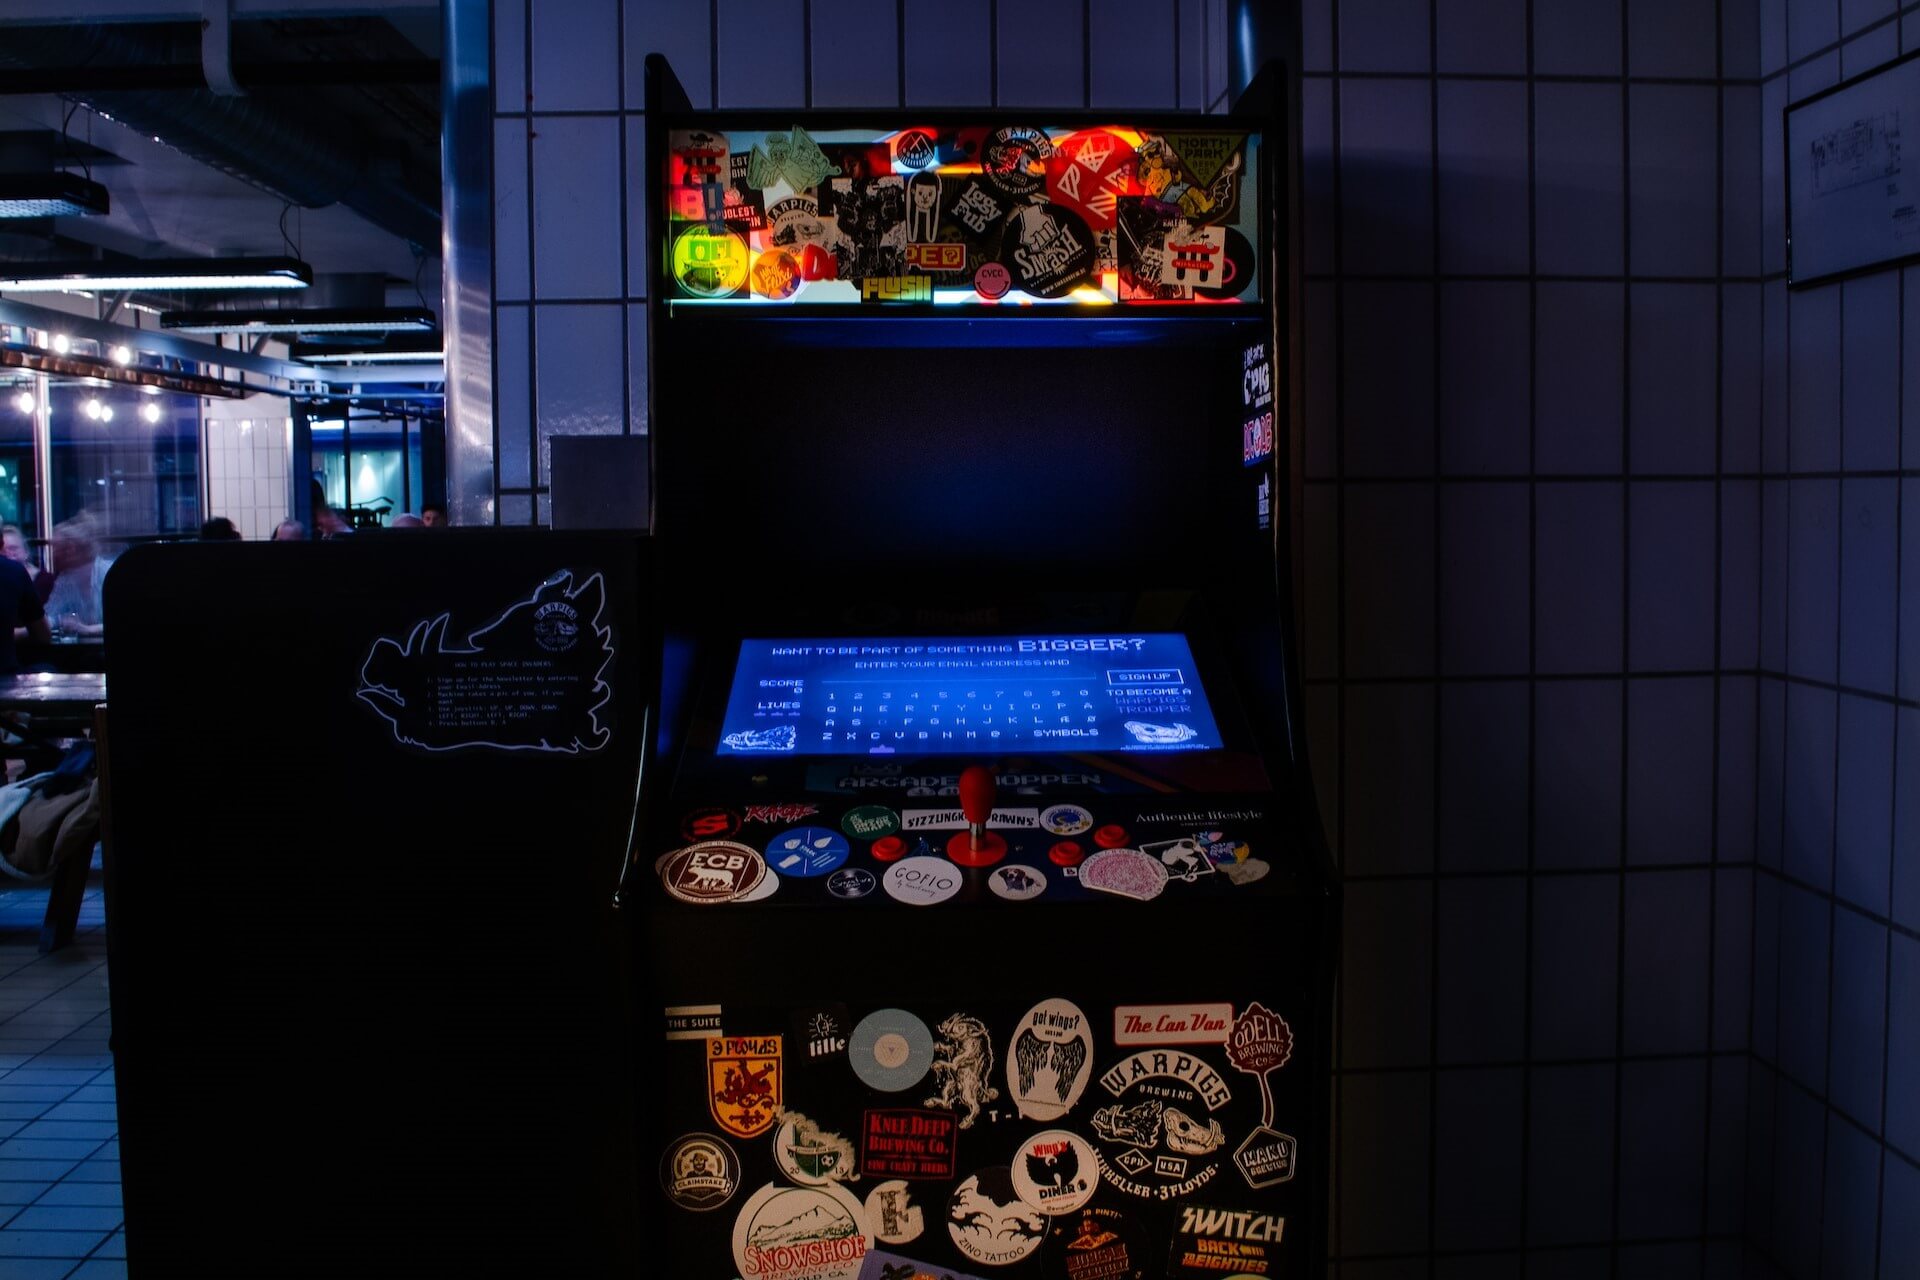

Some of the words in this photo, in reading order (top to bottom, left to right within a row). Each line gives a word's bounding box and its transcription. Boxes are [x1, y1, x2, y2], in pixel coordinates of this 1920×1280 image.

[1178, 137, 1231, 151] NORTH
[1184, 149, 1225, 160] PARK
[772, 646, 812, 656] WANT
[816, 646, 836, 655] TO
[838, 646, 859, 655] BE
[861, 646, 901, 655] PART
[904, 645, 924, 655] OF
[927, 644, 1013, 655] SOMETHING
[1018, 638, 1146, 653] BIGGER?
[855, 660, 899, 669] ENTER
[901, 660, 936, 669] YOUR
[938, 660, 978, 668] EMAIL
[981, 659, 1042, 667] ADDRESS
[1044, 658, 1070, 667] AND
[759, 679, 804, 687] SCORE
[1118, 672, 1152, 681] SIGN
[1153, 672, 1171, 680] UP
[1106, 688, 1122, 697] TO
[1123, 688, 1179, 696] BECOME
[1181, 687, 1192, 696] A
[1115, 696, 1187, 704] WARPIGS
[758, 701, 801, 709] LIVES
[1116, 705, 1192, 713] TROOPER
[1033, 728, 1099, 737] SYMBOLS
[1135, 812, 1204, 823] Authentic
[1207, 810, 1263, 822] lifestyle
[690, 852, 745, 869] ECB
[668, 1019, 688, 1028] THE
[691, 1017, 721, 1028] SUITE
[1032, 1009, 1047, 1026] got
[1049, 1011, 1080, 1030] wings?
[1124, 1015, 1153, 1033] The
[1156, 1014, 1188, 1032] Can
[1190, 1013, 1226, 1031] Van
[1235, 1015, 1284, 1049] ODELL
[810, 1037, 846, 1057] lille
[1237, 1042, 1284, 1061] BREWING
[1101, 1053, 1229, 1109] WARPIGS
[1139, 1084, 1194, 1101] BREWING
[869, 1135, 925, 1152] BREWING
[1243, 1141, 1288, 1167] MAKU
[789, 1166, 801, 1175] 20
[1160, 1160, 1181, 1172] USA
[1038, 1183, 1075, 1199] DINER
[1180, 1206, 1285, 1244] SWITCH
[744, 1234, 866, 1275] SNOWSHOE
[959, 1237, 981, 1257] ZINO
[985, 1246, 1026, 1262] TATTOO
[1196, 1238, 1240, 1255] BACK
[762, 1264, 829, 1280] BREWING
[833, 1261, 857, 1270] CO.
[1195, 1254, 1269, 1273] EIGHTIES
